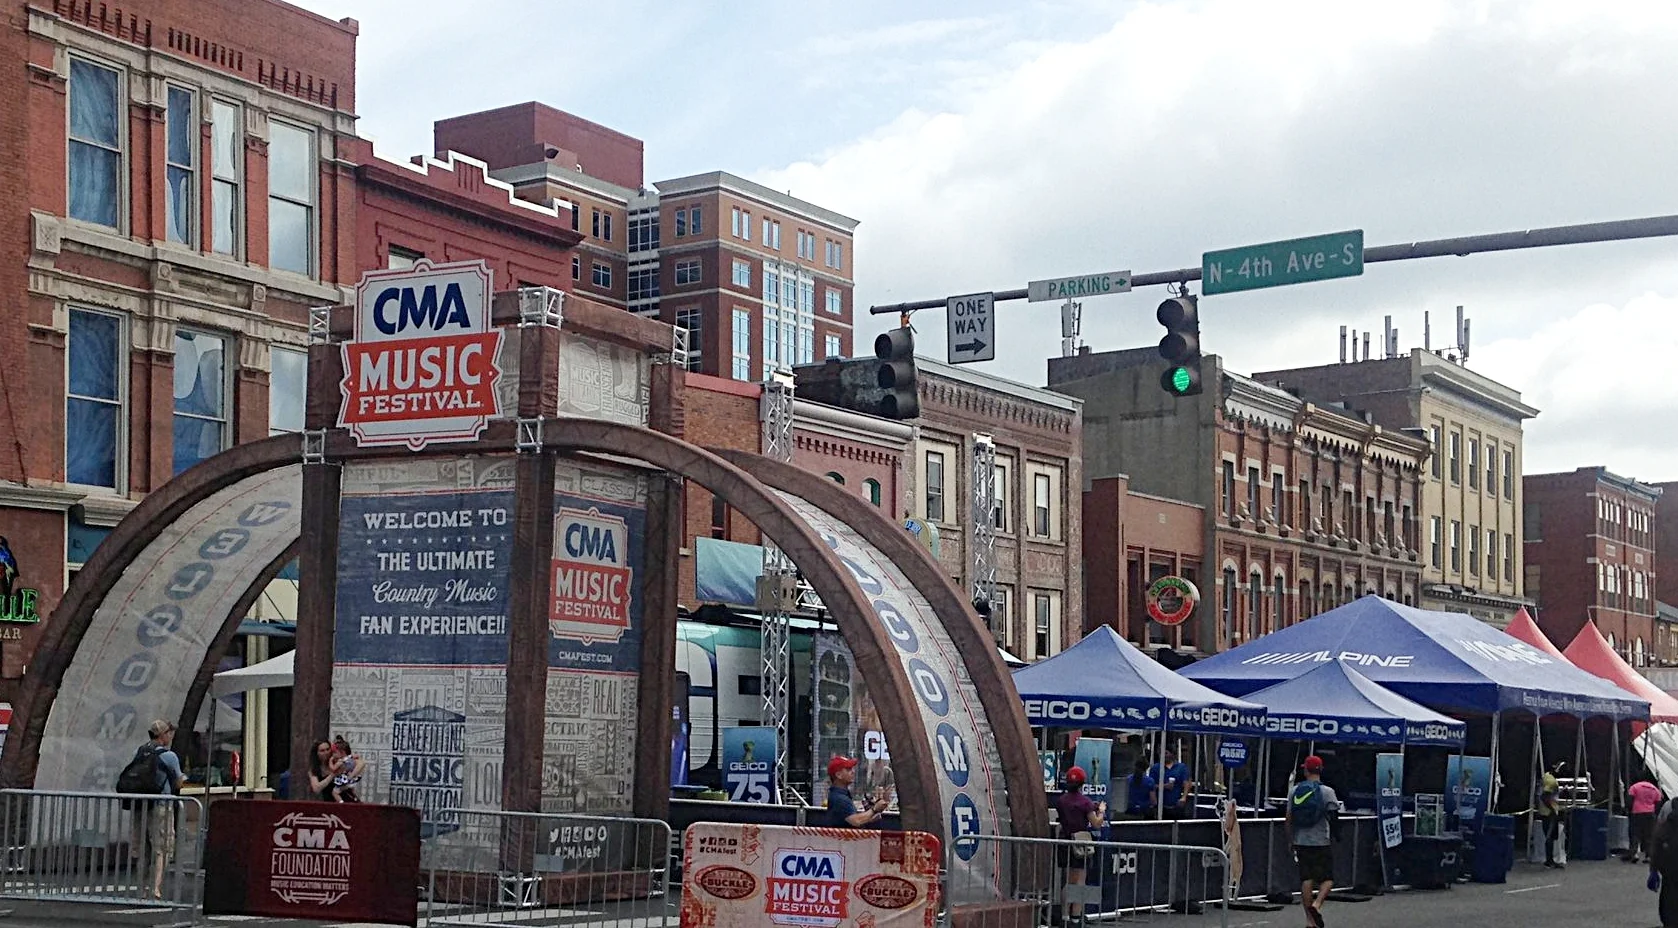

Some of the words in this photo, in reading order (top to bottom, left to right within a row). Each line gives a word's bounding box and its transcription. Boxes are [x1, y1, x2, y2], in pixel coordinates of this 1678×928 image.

[1048, 276, 1111, 298] PARKING
[373, 282, 471, 335] CMA
[955, 299, 987, 317] ONE
[954, 316, 988, 335] WAY
[358, 343, 483, 394] MUSIC
[358, 389, 482, 416] FESTIVAL
[364, 509, 472, 530] WELCOME
[478, 508, 507, 526] TO
[565, 522, 617, 563] CMA
[377, 551, 410, 572] THE
[417, 550, 495, 571] ULTIMATE
[372, 581, 438, 609] Country
[445, 578, 499, 602] Music
[555, 567, 622, 605] MUSIC
[554, 600, 621, 620] FESTIVAL
[360, 615, 393, 636] FAN
[399, 614, 506, 636] EXPERIENCE!!
[558, 651, 614, 664] CMAFEST.COM
[593, 679, 619, 715] REAL
[1021, 699, 1091, 720] EICO
[1201, 707, 1240, 728] GEICO
[1266, 717, 1339, 735] GEICO
[1425, 724, 1448, 739] GEICO
[390, 756, 465, 785] MUSIC
[729, 761, 768, 771] GEICO
[727, 773, 771, 804] 75
[273, 827, 350, 849] CMA
[699, 846, 737, 855] #CMAfest
[271, 852, 351, 877] FOUNDATION
[781, 854, 835, 879] CMA
[707, 877, 750, 889] BUCKLE
[773, 881, 842, 905] MUSIC
[867, 887, 911, 898] BUCKLE
[772, 901, 840, 915] FESTIVAL
